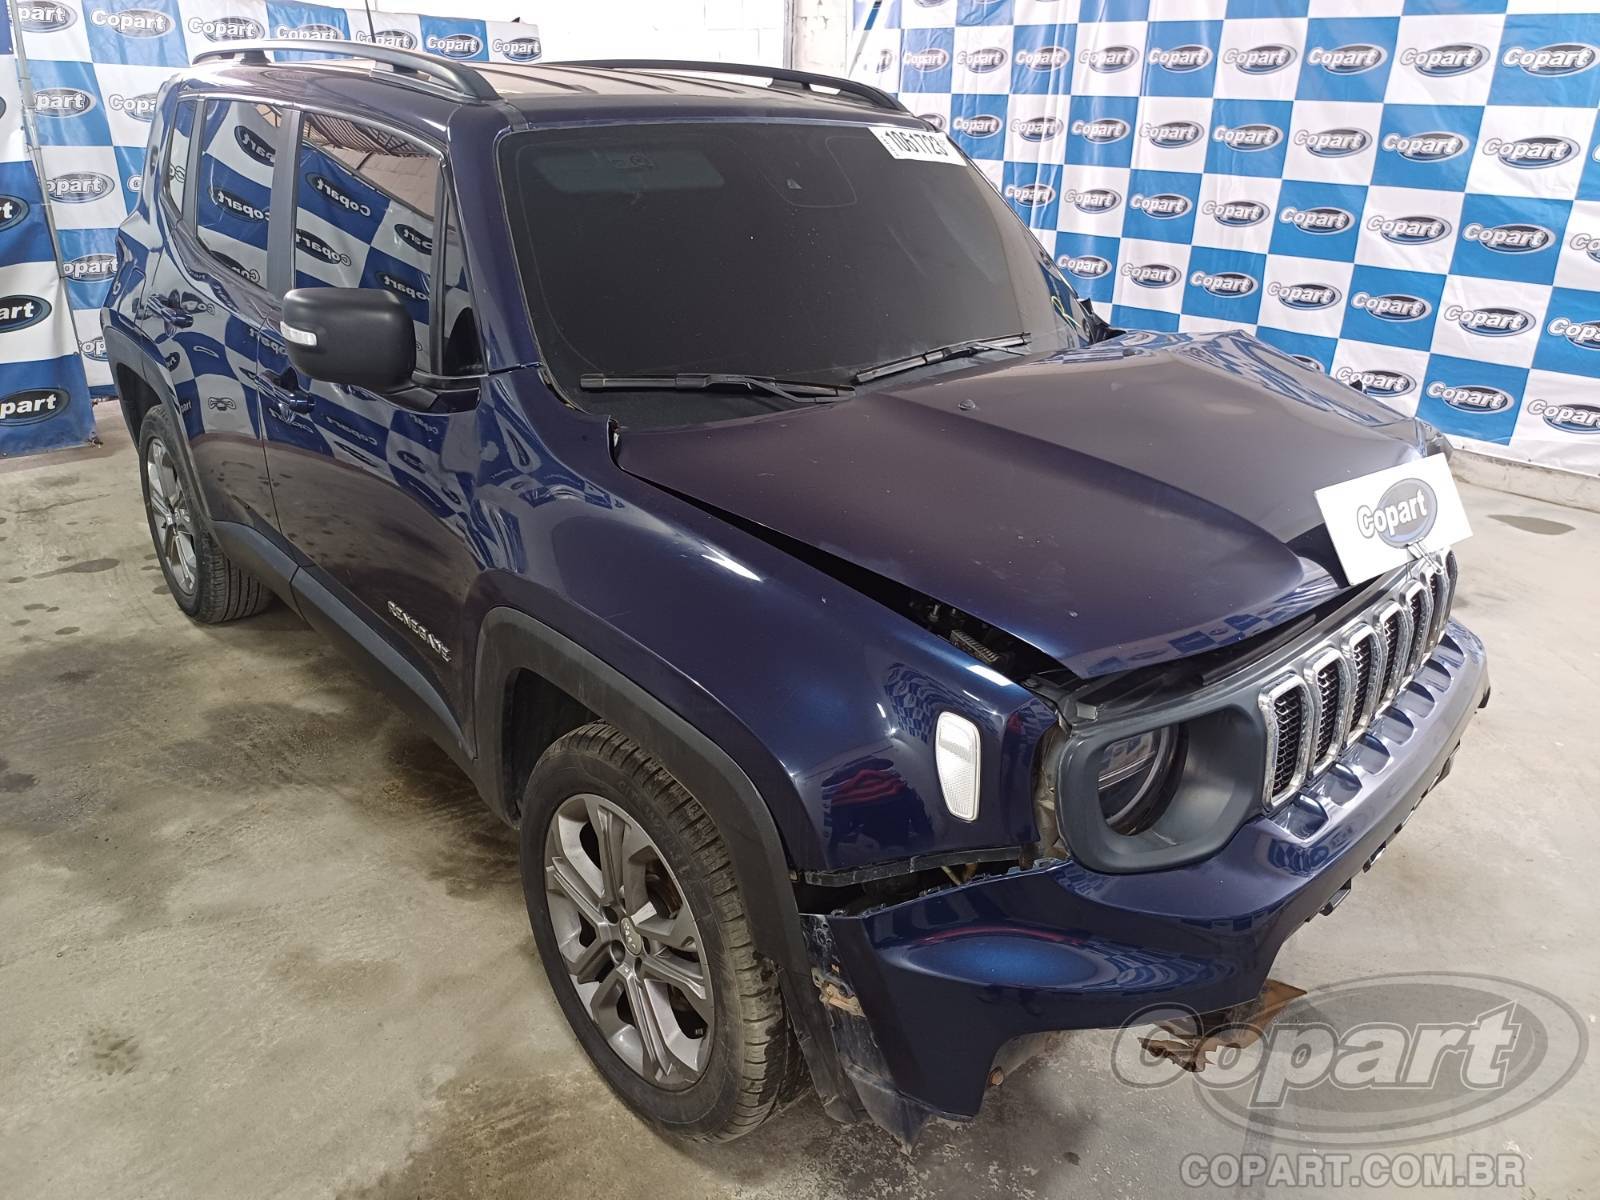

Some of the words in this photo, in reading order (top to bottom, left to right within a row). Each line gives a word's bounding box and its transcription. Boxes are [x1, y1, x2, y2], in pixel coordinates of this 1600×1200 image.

[18, 7, 66, 23] part
[91, 9, 165, 30] Copart
[188, 17, 256, 39] Copart
[276, 25, 337, 40] Copart
[356, 31, 409, 48] Copart
[427, 36, 478, 54] Copart
[492, 39, 541, 56] Copart
[956, 48, 1001, 69] Copart
[1015, 48, 1061, 68] Copart
[1079, 48, 1132, 69] Copart
[1148, 47, 1206, 69] Copart
[1223, 47, 1289, 69] Copart
[1307, 47, 1383, 70] Copart
[1400, 46, 1482, 71] Copart
[1503, 46, 1589, 71] Copart
[35, 93, 85, 112] part
[108, 93, 156, 113] Copa
[953, 117, 998, 136] Copart
[1010, 118, 1059, 137] Copart
[1071, 120, 1123, 139] Copart
[1140, 123, 1198, 144] Copart
[1212, 125, 1277, 148] Copart
[1294, 129, 1365, 153] Copart
[1382, 133, 1460, 158] Copart
[1482, 138, 1570, 164] Copart
[46, 176, 102, 195] opart
[1005, 185, 1051, 204] Copart
[1064, 189, 1116, 209] Copart
[1130, 194, 1185, 215] Copart
[1201, 200, 1262, 223] Copart
[1279, 207, 1348, 231] Copart
[1367, 215, 1442, 239] Copart
[1463, 223, 1545, 249] Copart
[63, 258, 117, 278] opart
[1057, 254, 1105, 273] Copart
[1121, 262, 1175, 283] Copart
[1189, 271, 1251, 293] Copart
[1267, 281, 1335, 305] Copart
[0, 300, 35, 320] art
[1351, 291, 1424, 317] Copart
[1444, 305, 1524, 332] Copart
[1336, 367, 1409, 392] Copart
[1426, 381, 1506, 409] Copart
[0, 393, 57, 419] part
[1356, 488, 1428, 539] Copart
